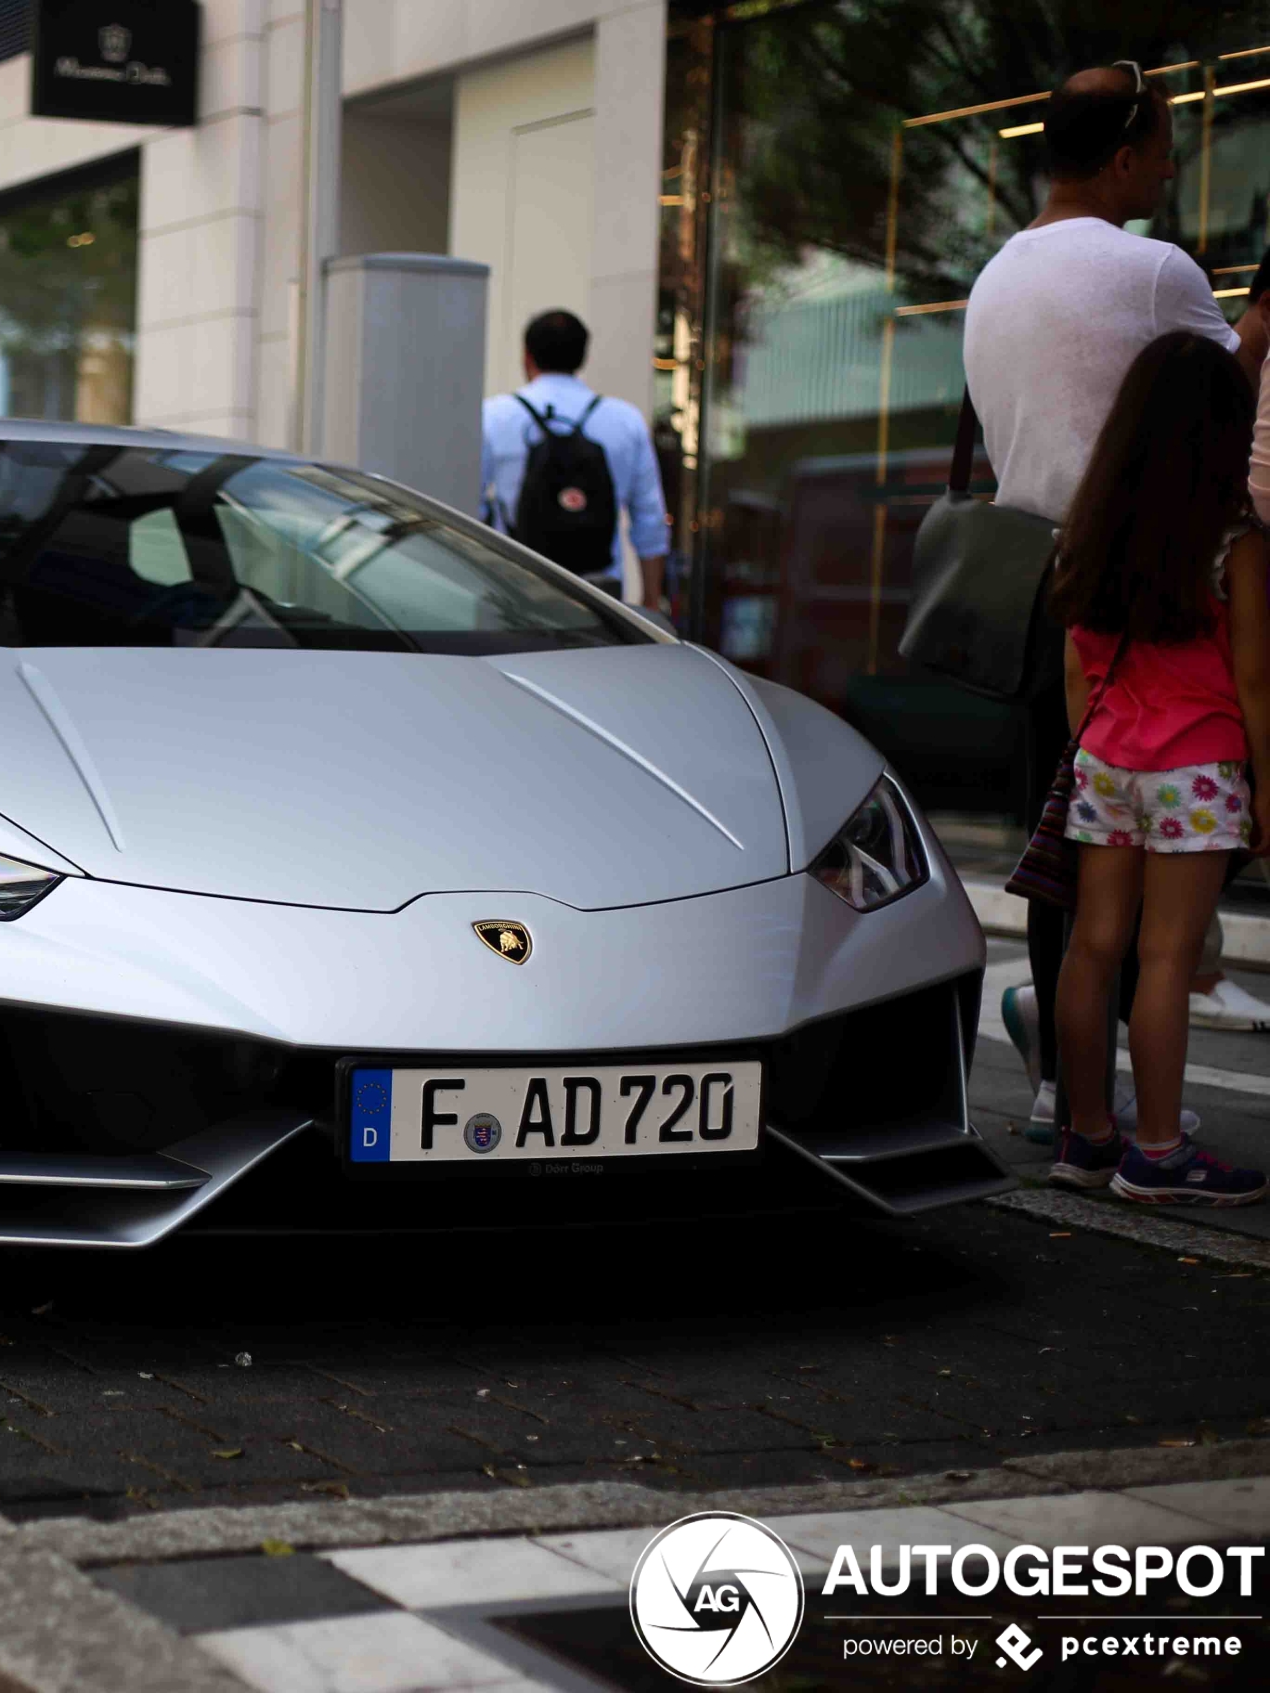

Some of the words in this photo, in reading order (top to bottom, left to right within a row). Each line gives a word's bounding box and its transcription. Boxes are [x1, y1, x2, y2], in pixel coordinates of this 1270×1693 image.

[421, 1079, 465, 1149] F
[516, 1077, 601, 1147] AD
[620, 1073, 734, 1144] 720
[363, 1127, 378, 1147] D
